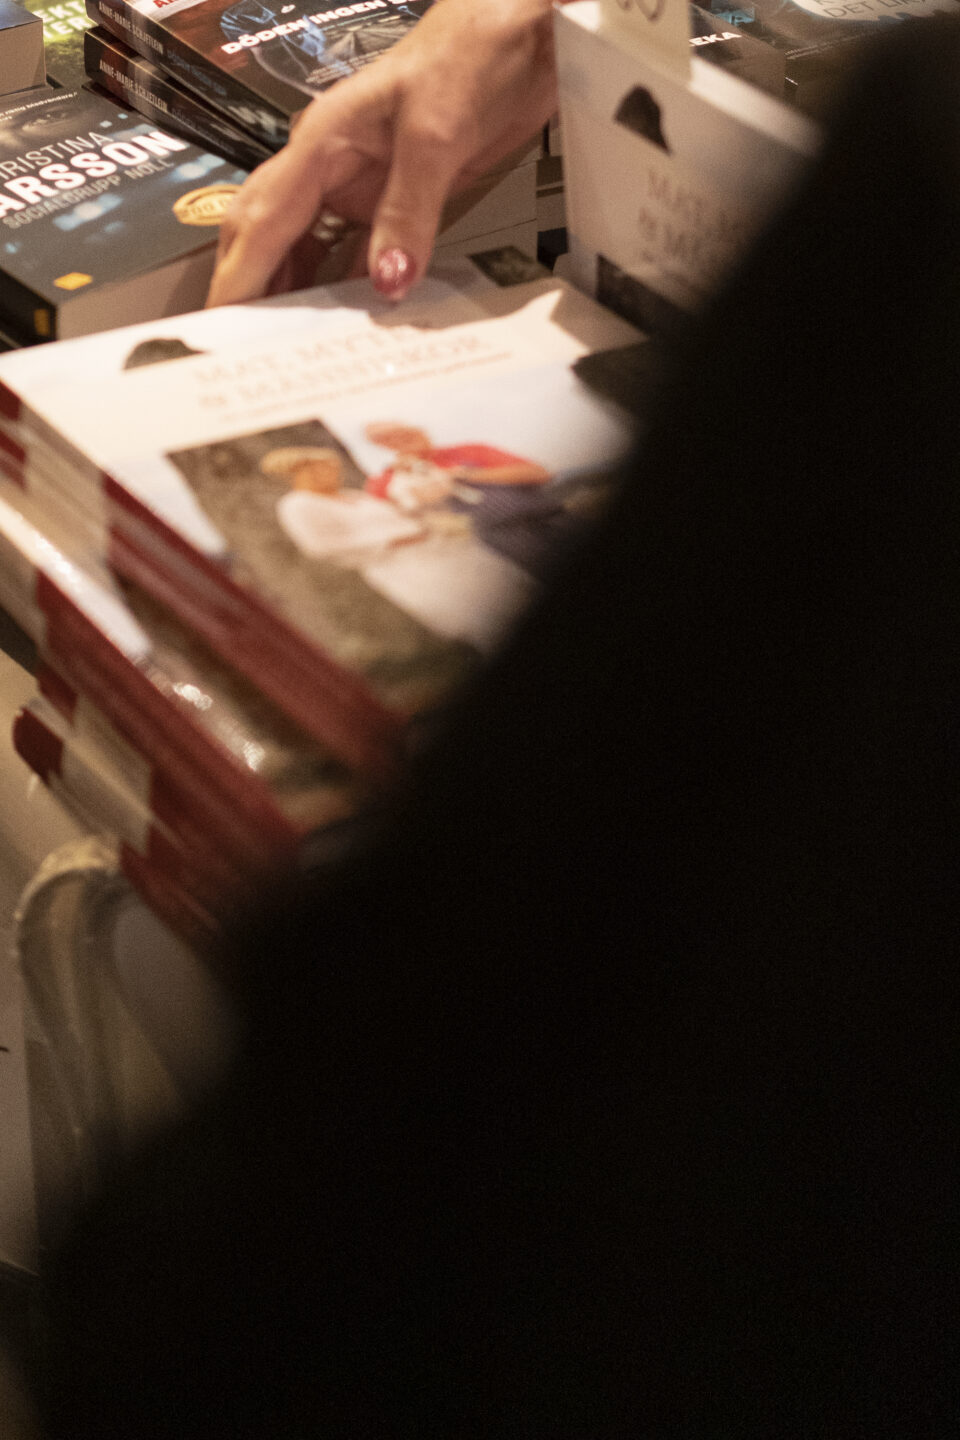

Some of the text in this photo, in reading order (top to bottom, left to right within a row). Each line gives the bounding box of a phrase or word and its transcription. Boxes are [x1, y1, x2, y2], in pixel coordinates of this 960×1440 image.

[220, 17, 311, 55] DÖDEN
[2, 157, 175, 230] SOCIALGRUPP NOLL
